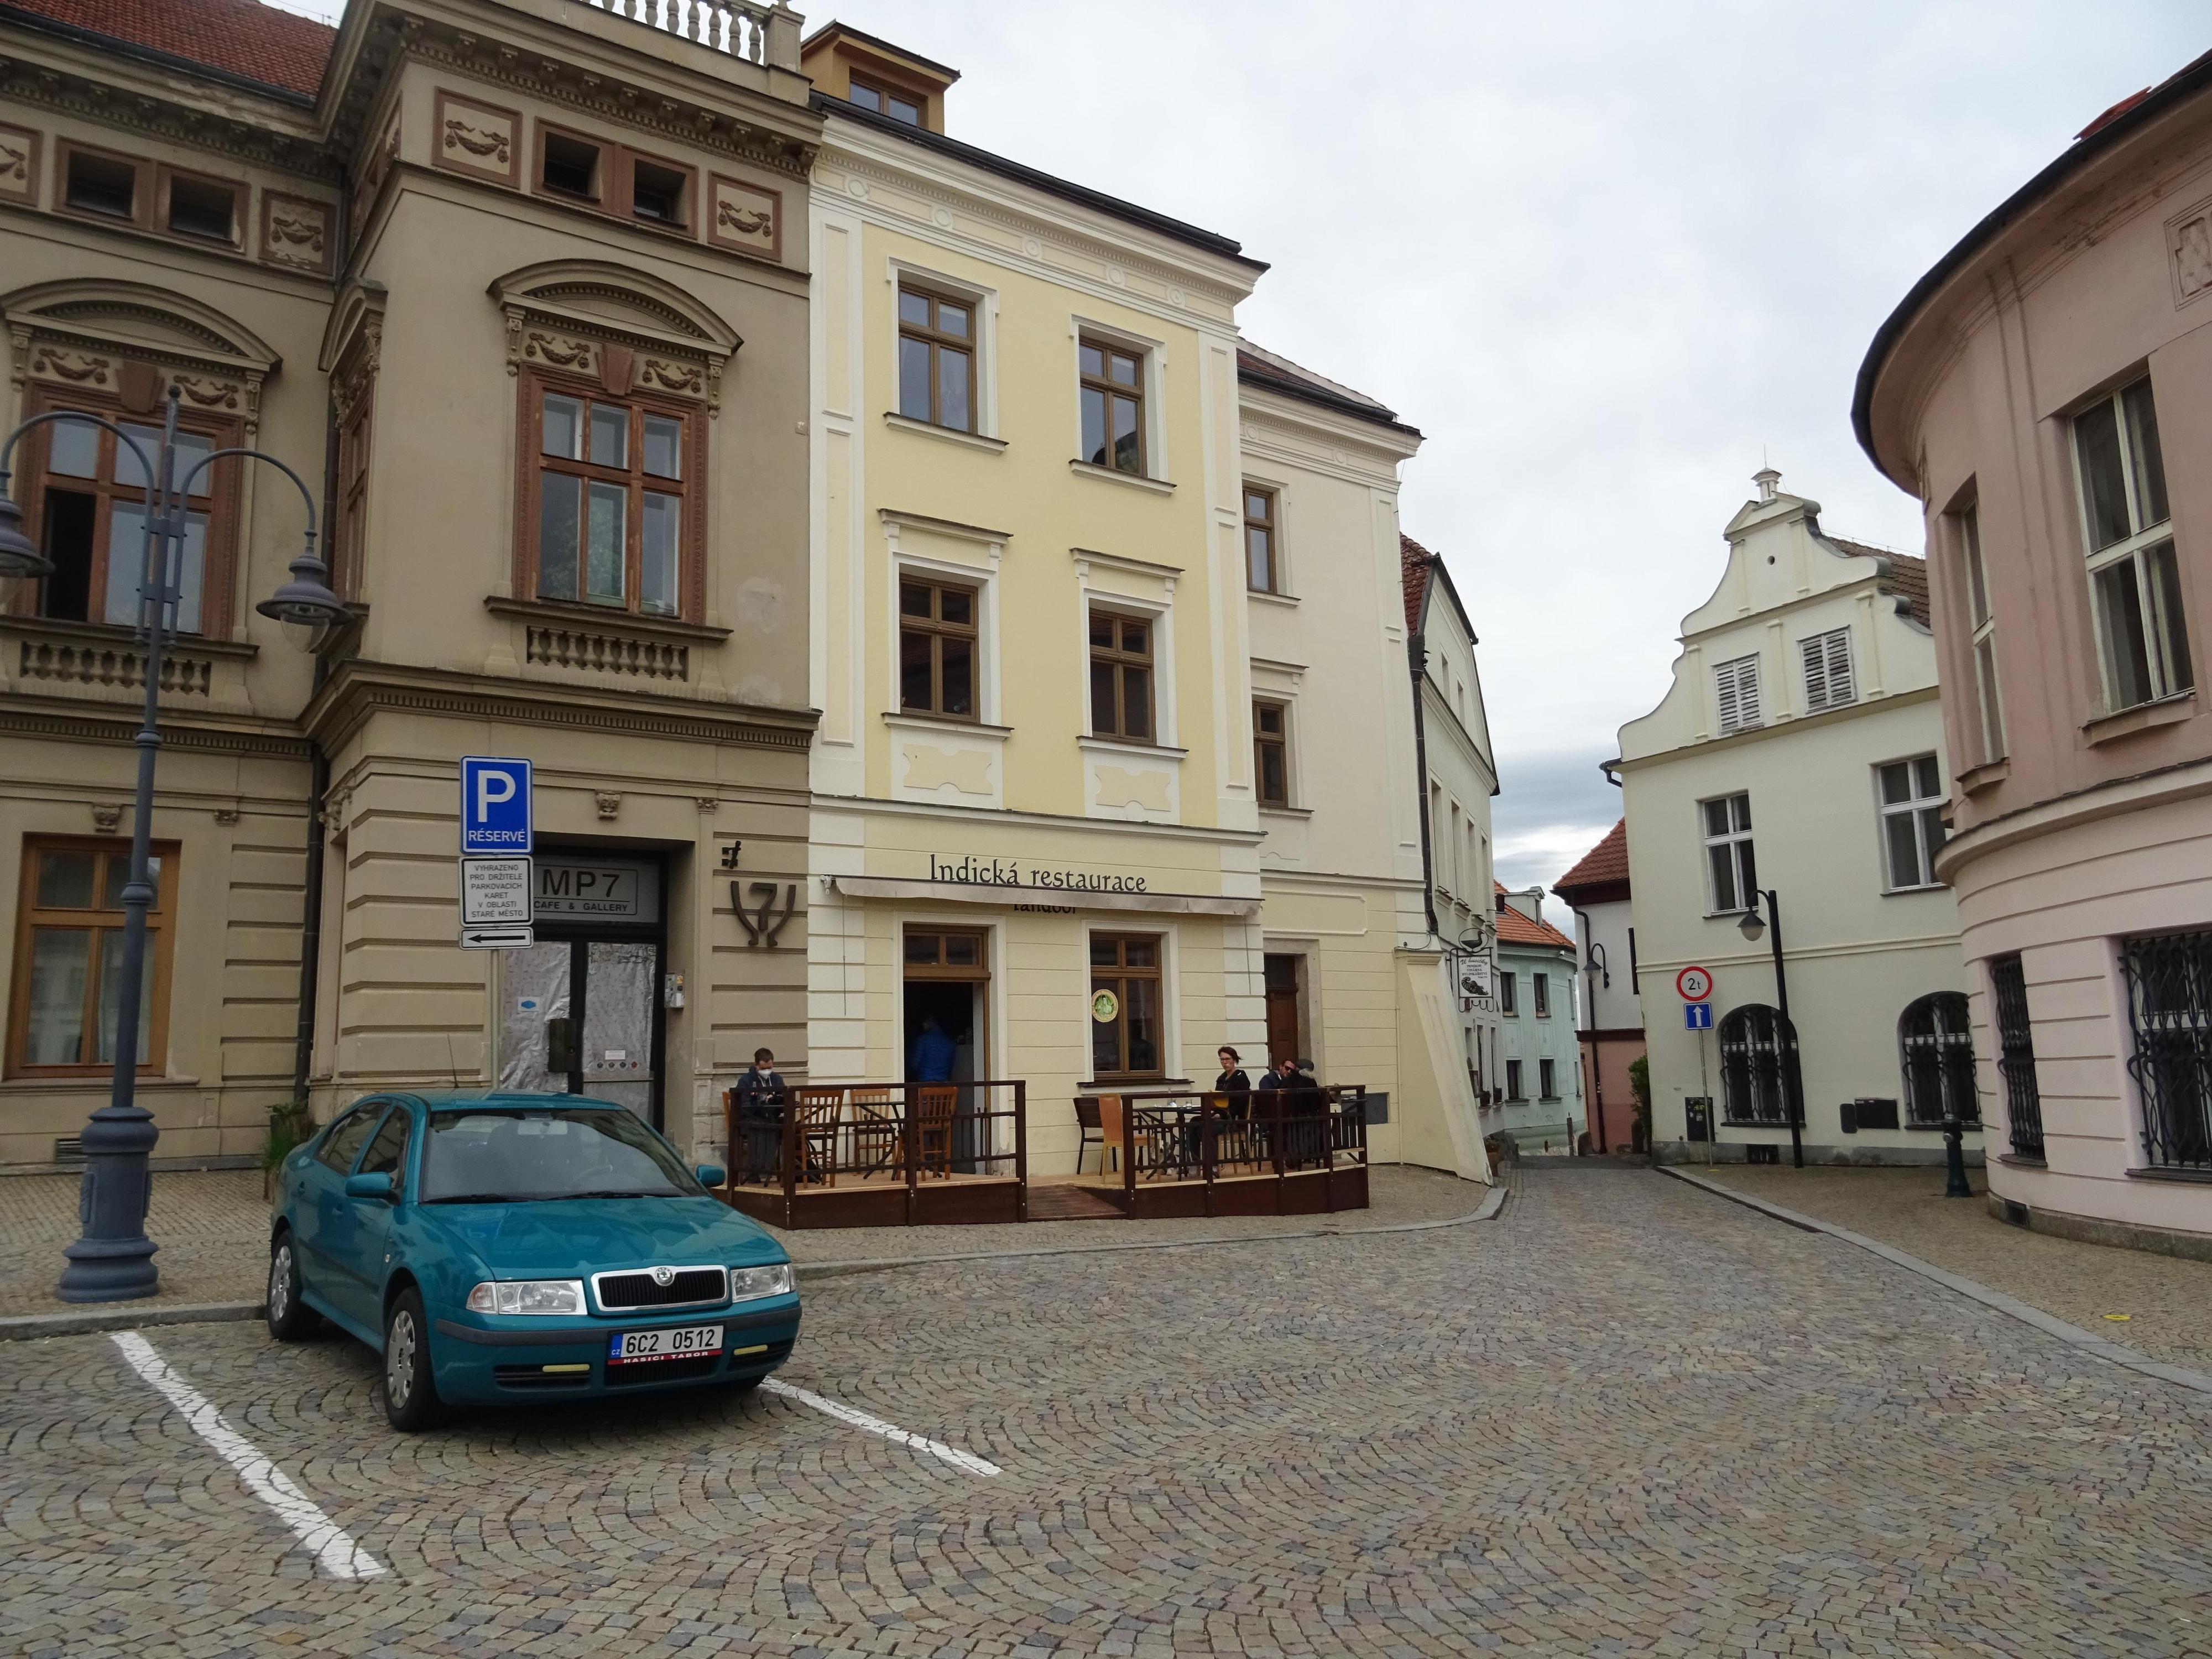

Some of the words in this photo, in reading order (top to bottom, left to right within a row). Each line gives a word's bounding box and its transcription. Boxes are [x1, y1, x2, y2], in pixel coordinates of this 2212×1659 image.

[478, 770, 516, 822] P
[468, 828, 526, 842] RÉSERVÉ
[930, 854, 1020, 885] Indická
[1030, 870, 1147, 892] restaurace
[534, 901, 560, 909] CAFE
[583, 902, 628, 912] GALLERY
[626, 1333, 660, 1354] 6C2
[672, 1329, 715, 1350] 0512
